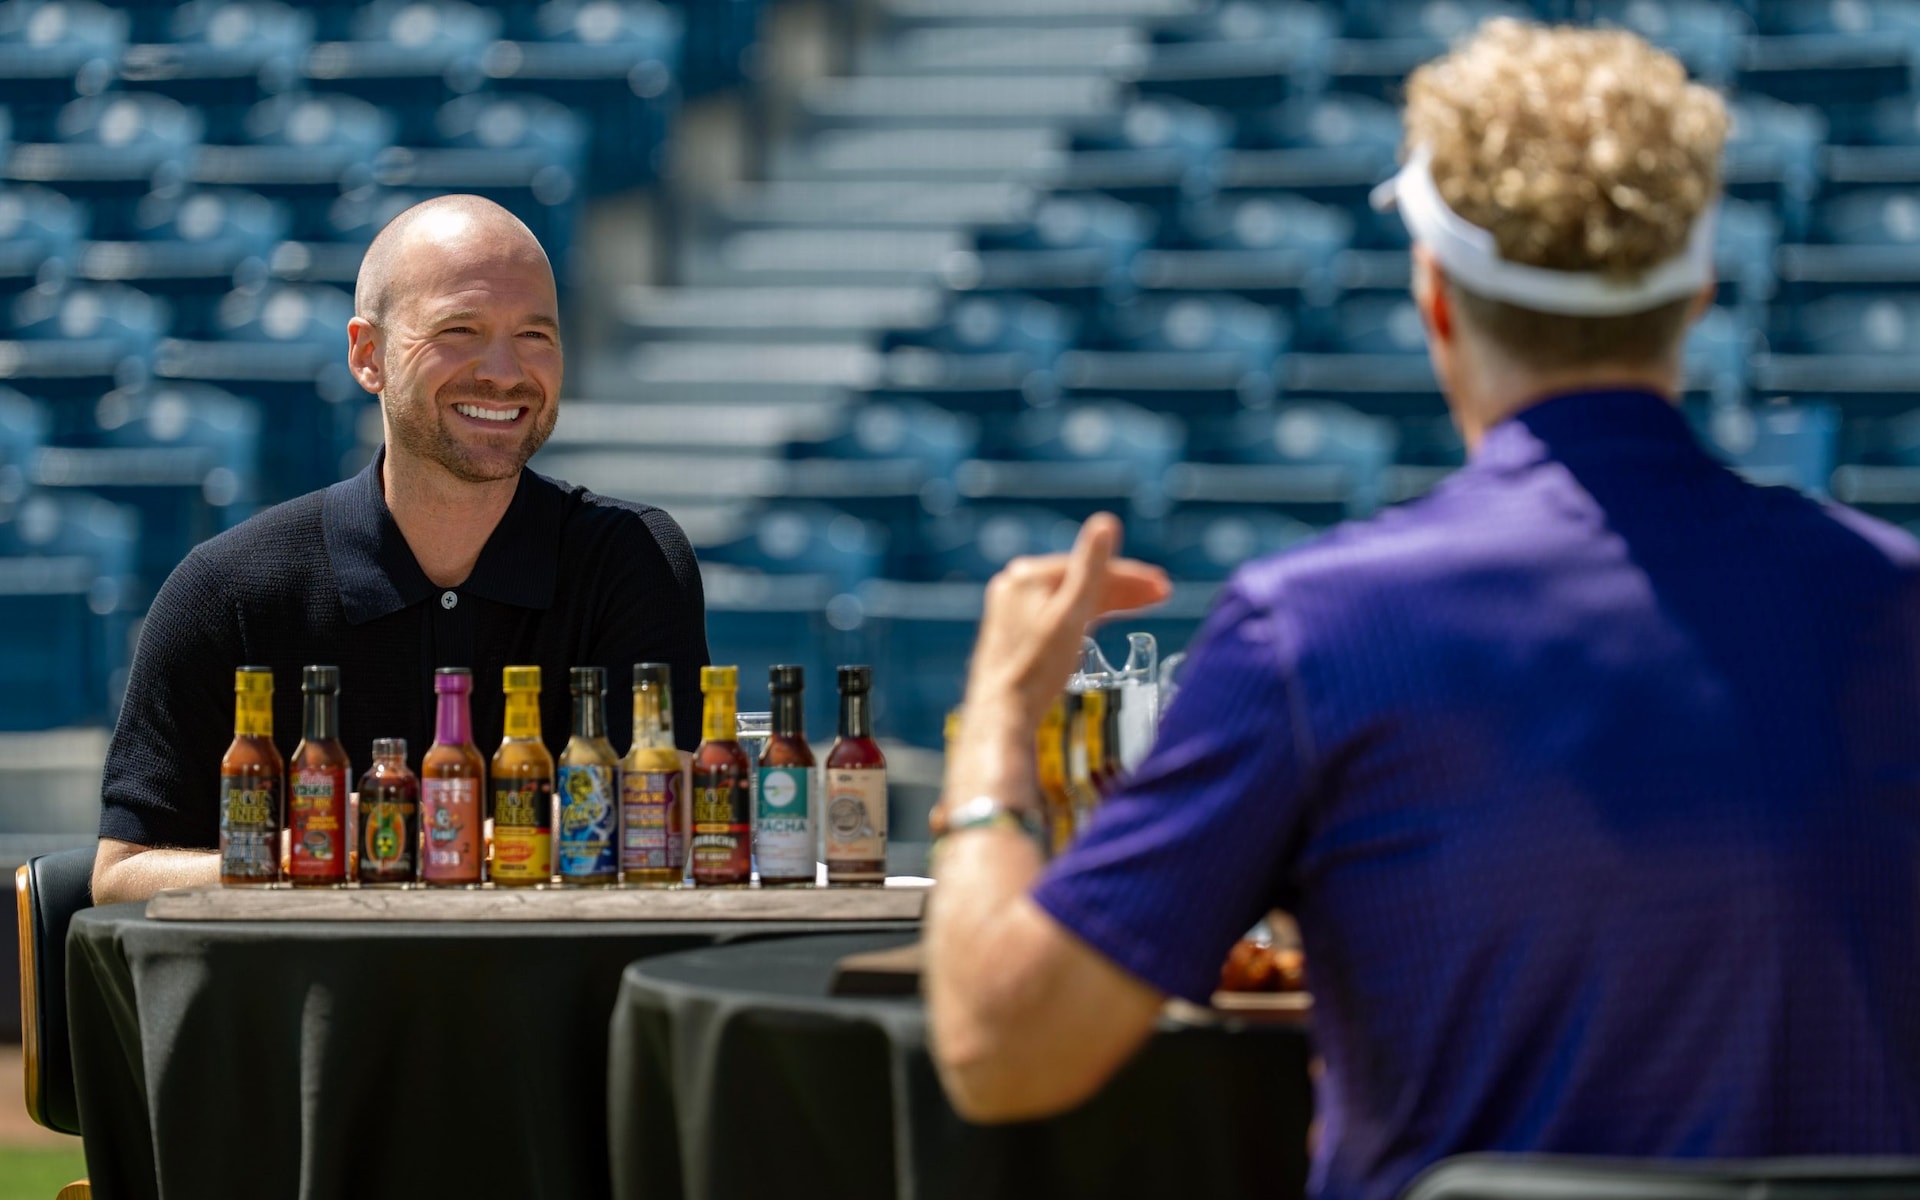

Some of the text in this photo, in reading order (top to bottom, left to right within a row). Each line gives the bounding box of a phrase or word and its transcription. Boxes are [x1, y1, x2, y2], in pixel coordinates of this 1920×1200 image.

[229, 789, 268, 806] HOT
[496, 790, 534, 807] HOT
[694, 787, 730, 803] HOT
[228, 806, 268, 824] ONES
